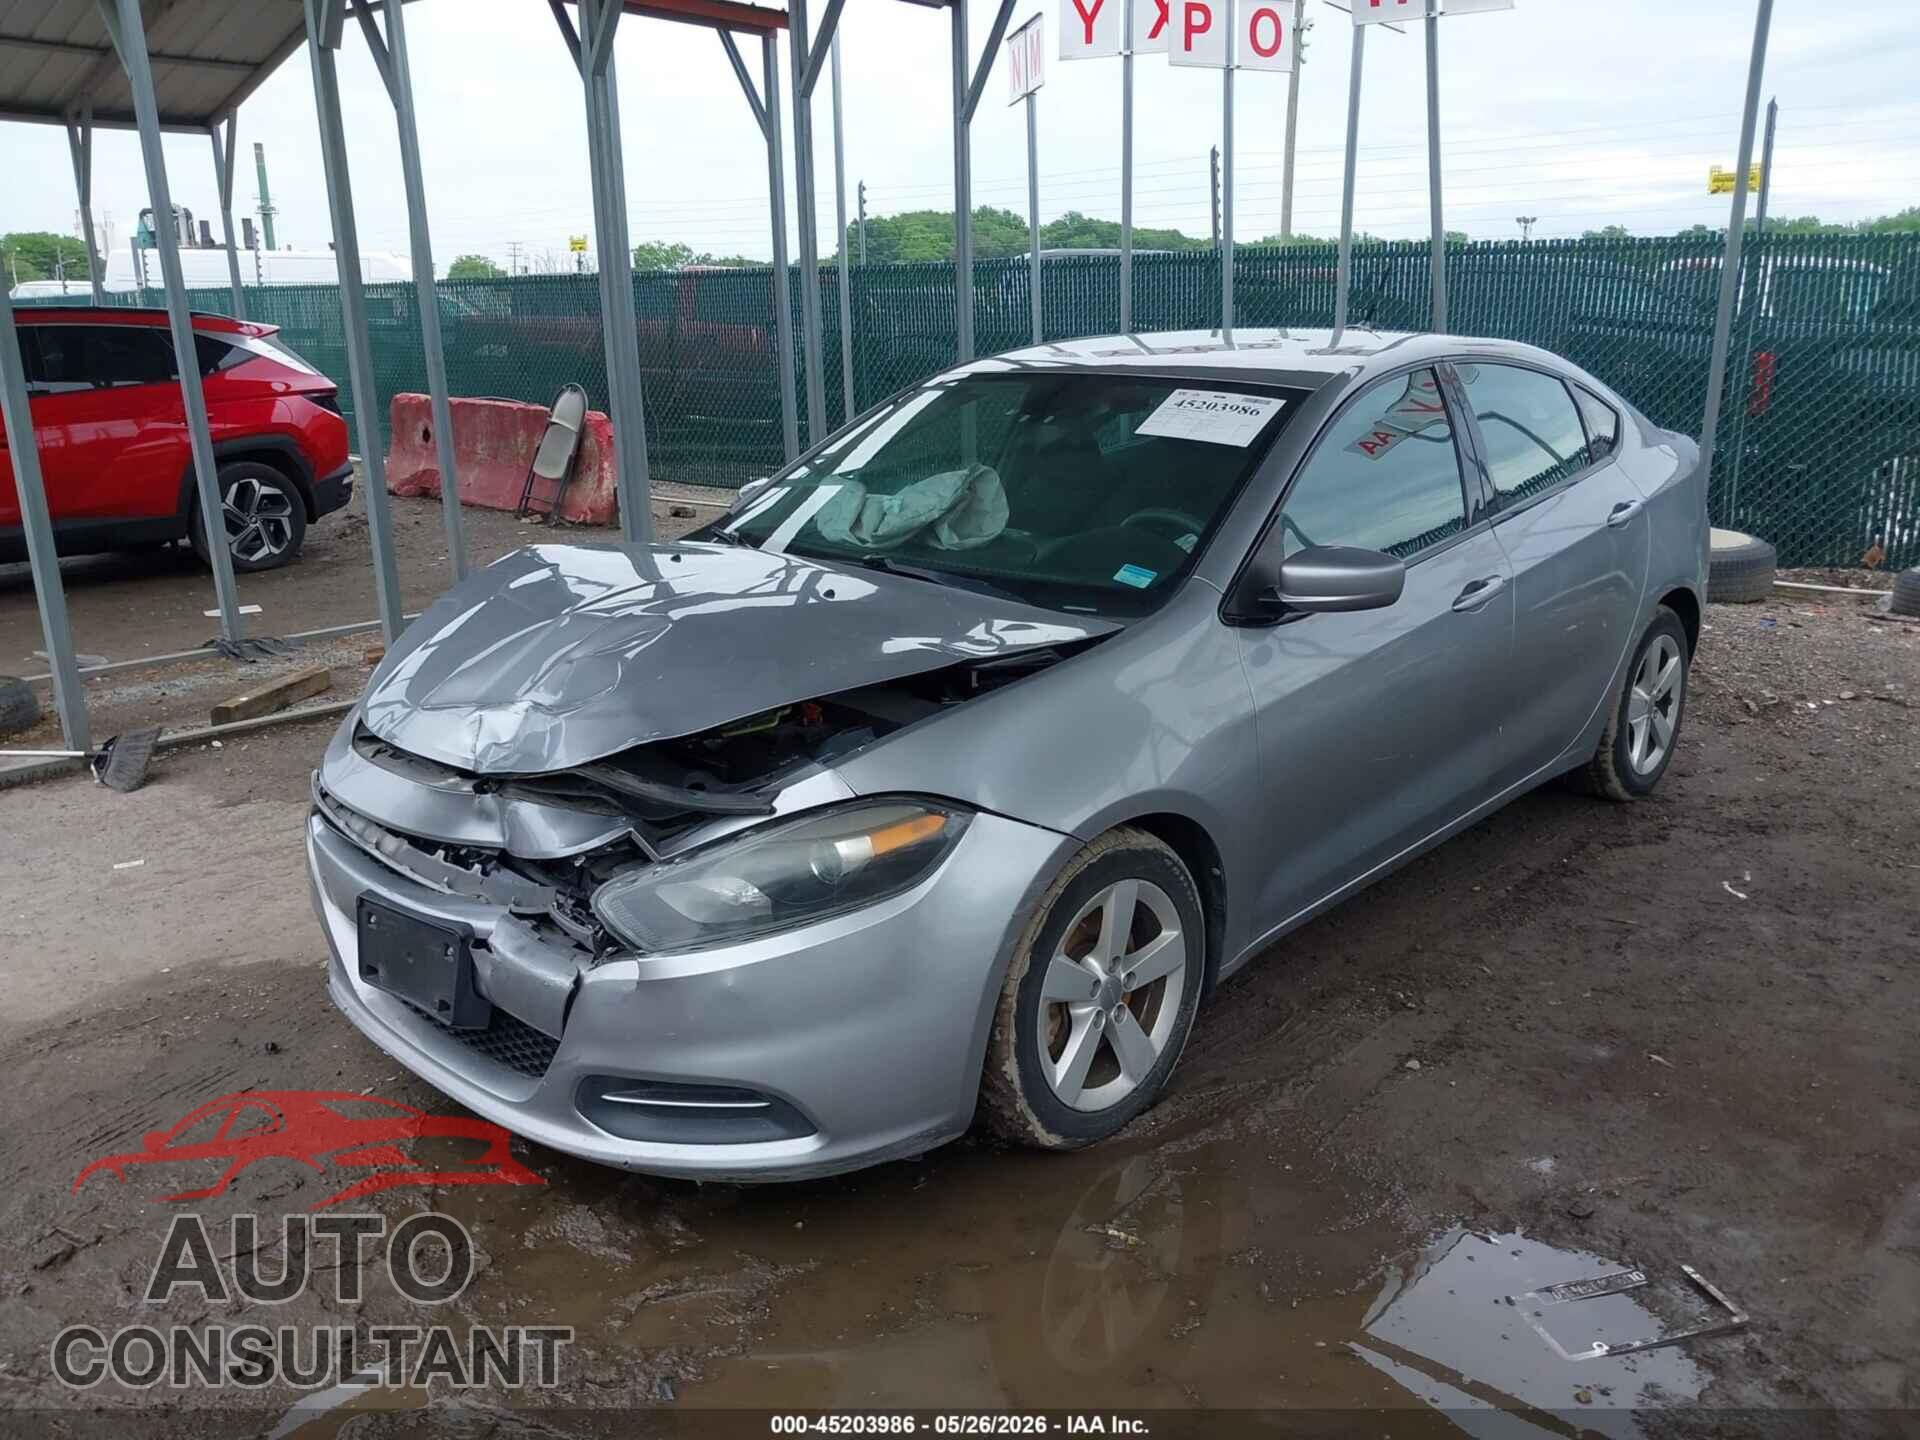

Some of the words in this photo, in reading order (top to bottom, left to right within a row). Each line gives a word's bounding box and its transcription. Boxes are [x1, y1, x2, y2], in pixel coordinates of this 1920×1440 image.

[1072, 0, 1105, 45] Y
[1184, 2, 1212, 52] P
[1249, 8, 1283, 58] O
[1173, 399, 1261, 417] 45203986
